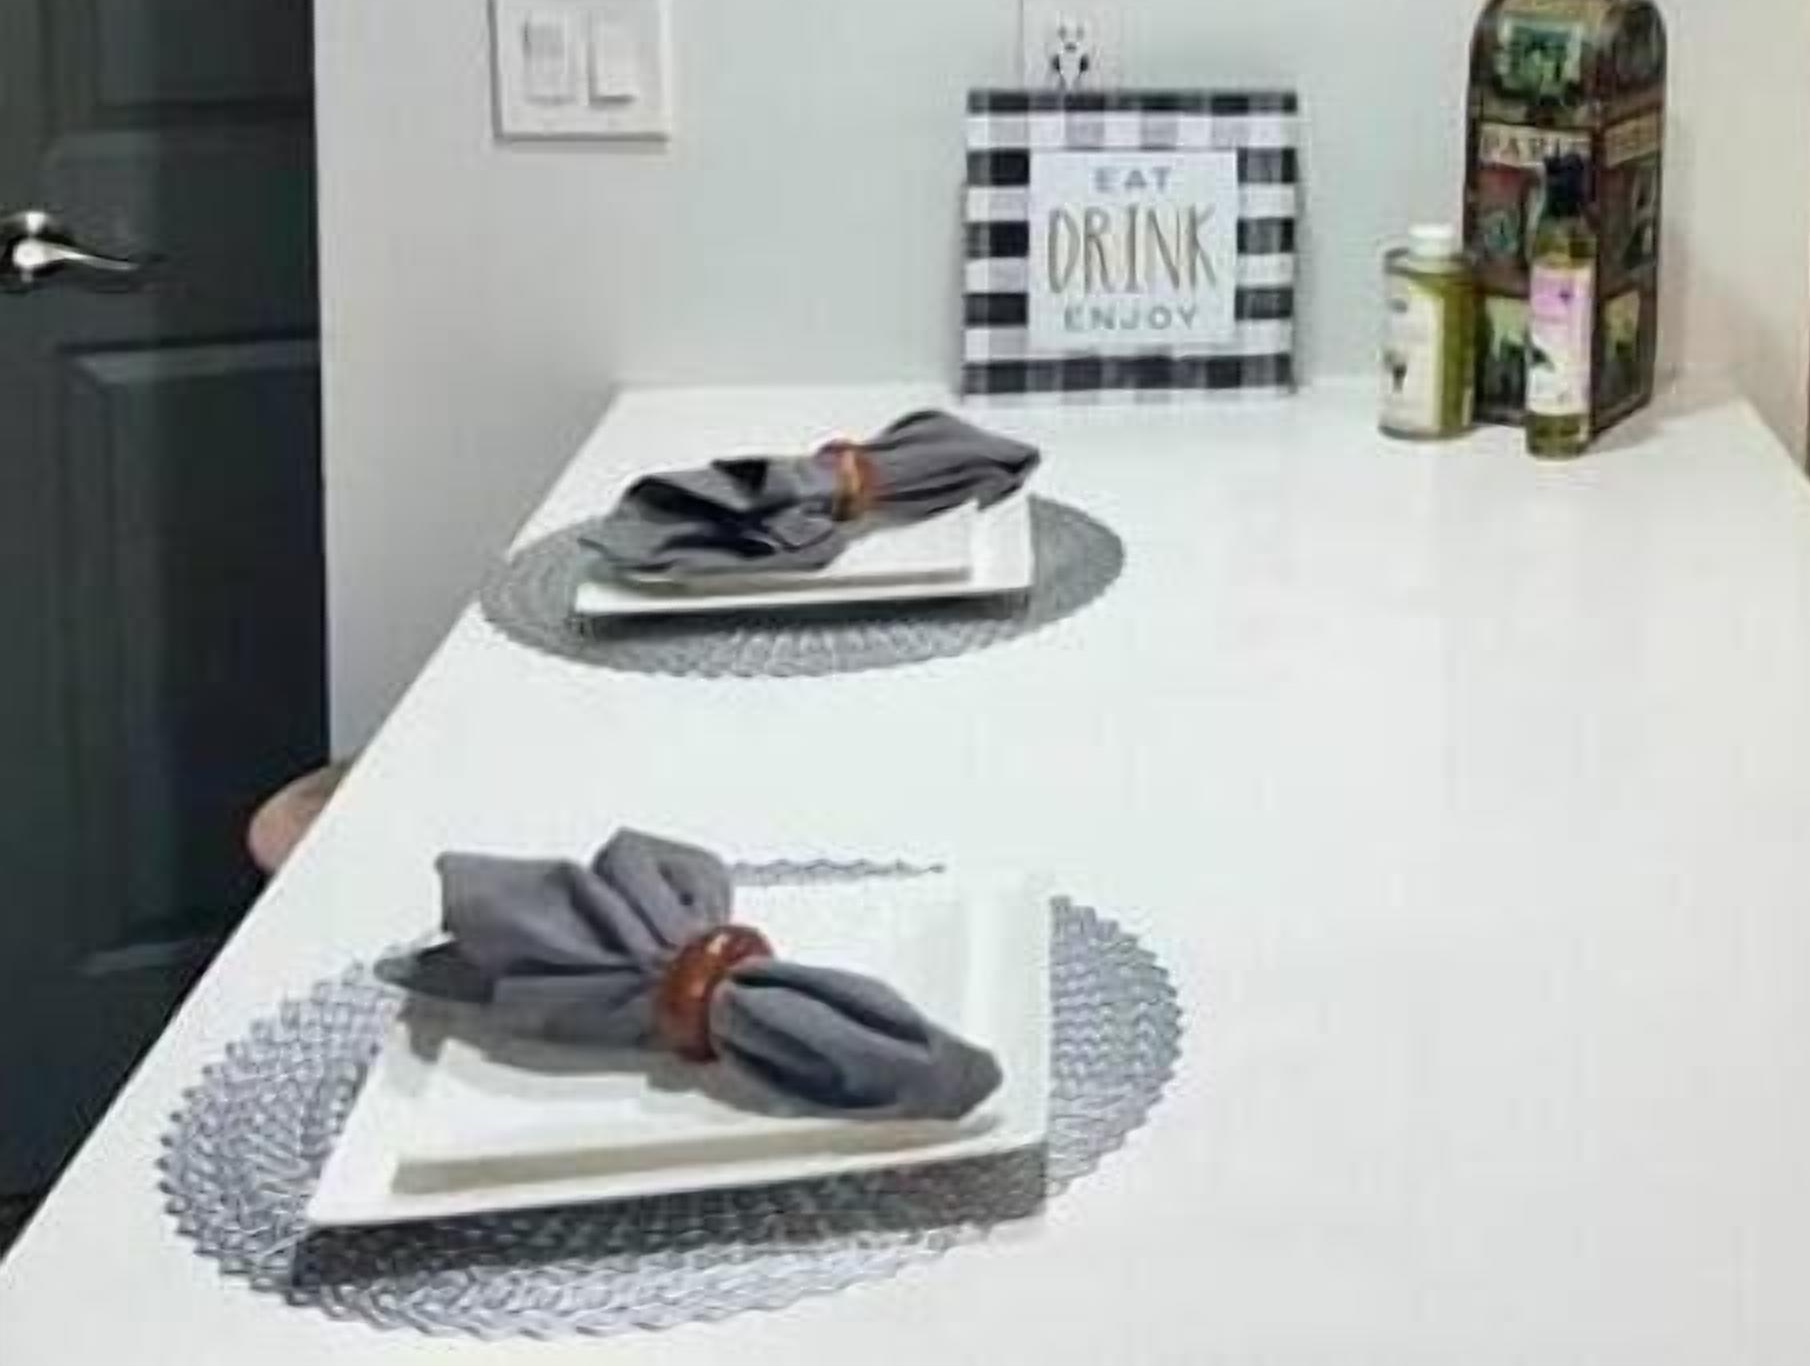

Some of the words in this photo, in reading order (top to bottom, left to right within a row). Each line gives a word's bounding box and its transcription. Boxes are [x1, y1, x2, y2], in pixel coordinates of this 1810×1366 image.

[1094, 166, 1172, 193] EAT
[1048, 202, 1218, 294] DRINK
[1063, 304, 1199, 331] ENJOY
